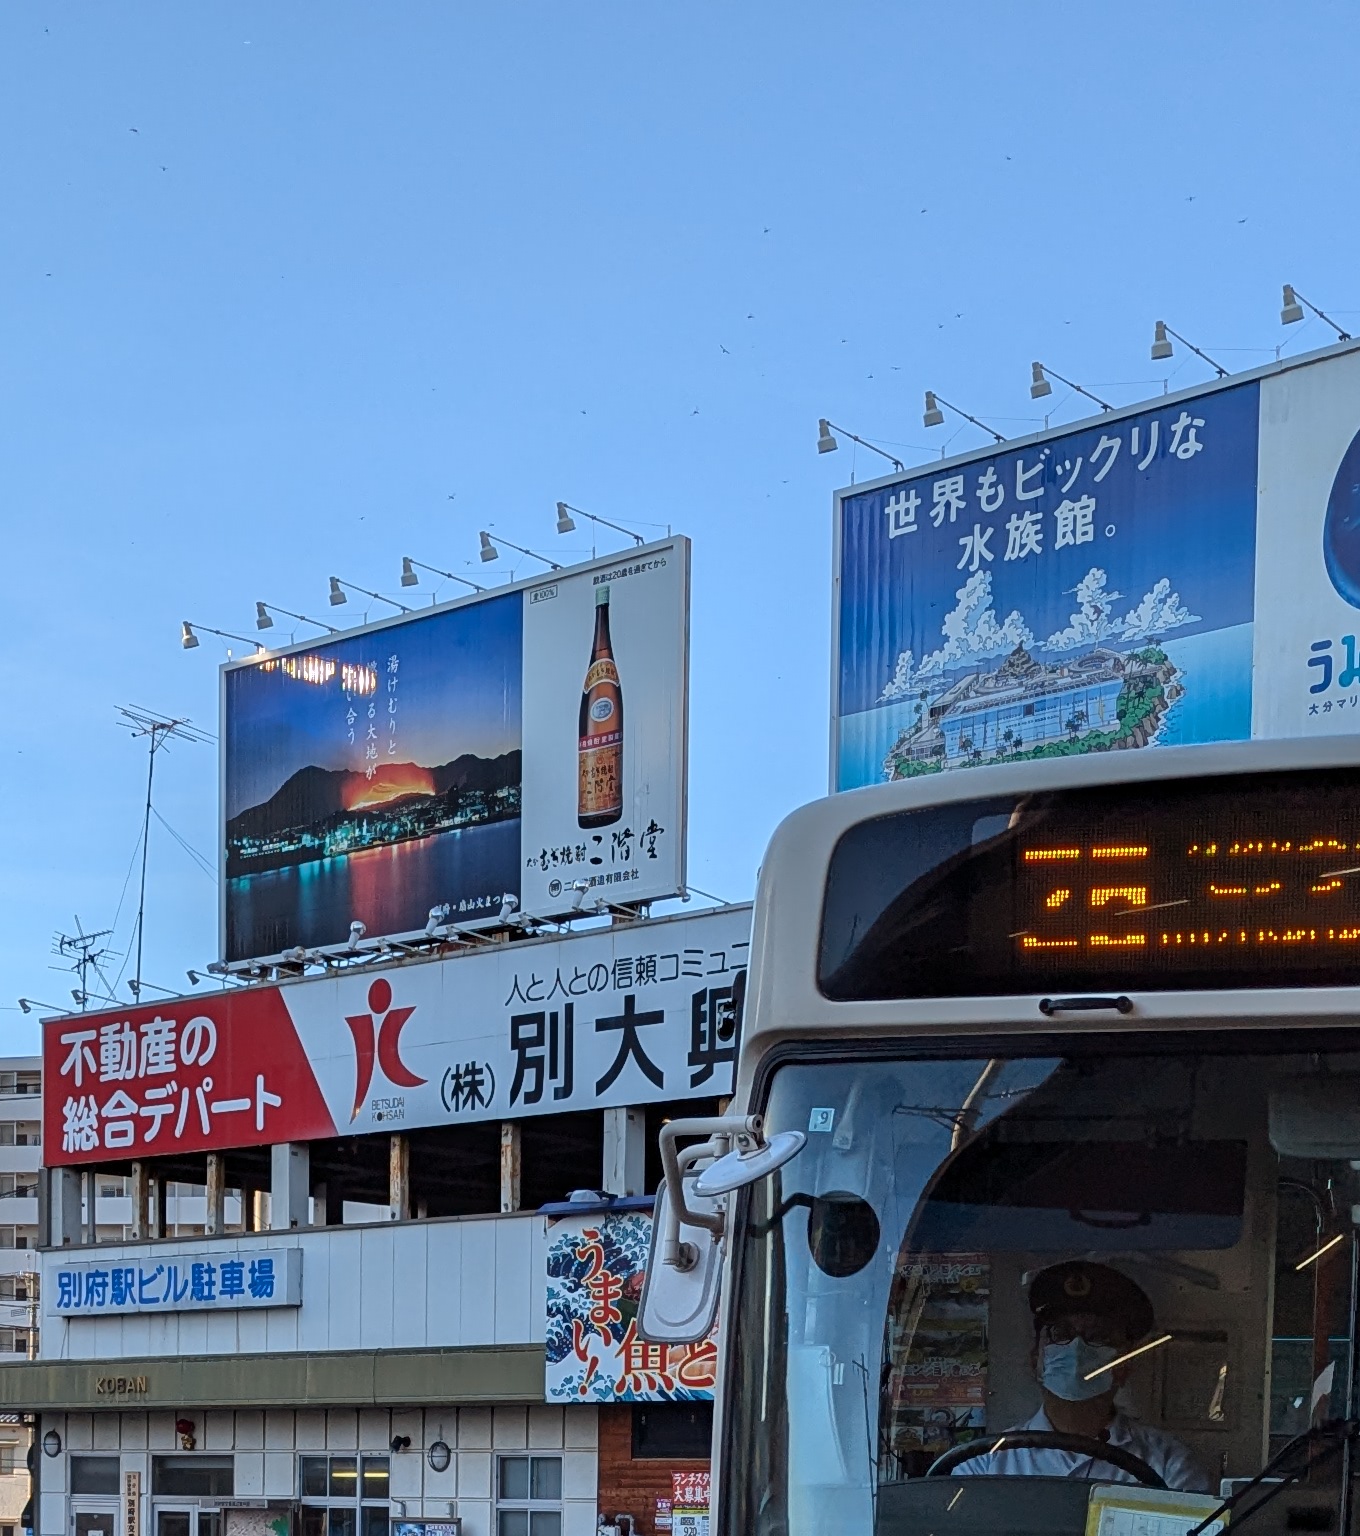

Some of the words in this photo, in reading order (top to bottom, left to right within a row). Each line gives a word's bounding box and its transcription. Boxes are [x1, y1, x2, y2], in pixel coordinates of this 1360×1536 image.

[885, 411, 1205, 540] 世界もビックリな
[959, 495, 1116, 572] 水族館。
[387, 654, 399, 755] 湯けむりと
[564, 869, 639, 891] 二酒造有限会社
[60, 1016, 217, 1087] 不動産の
[62, 1074, 282, 1153] 総合デパート
[57, 1259, 275, 1308] 別府駅ビル駐車場
[95, 1376, 147, 1394] KOBAN
[673, 1473, 711, 1485] ランチスタ
